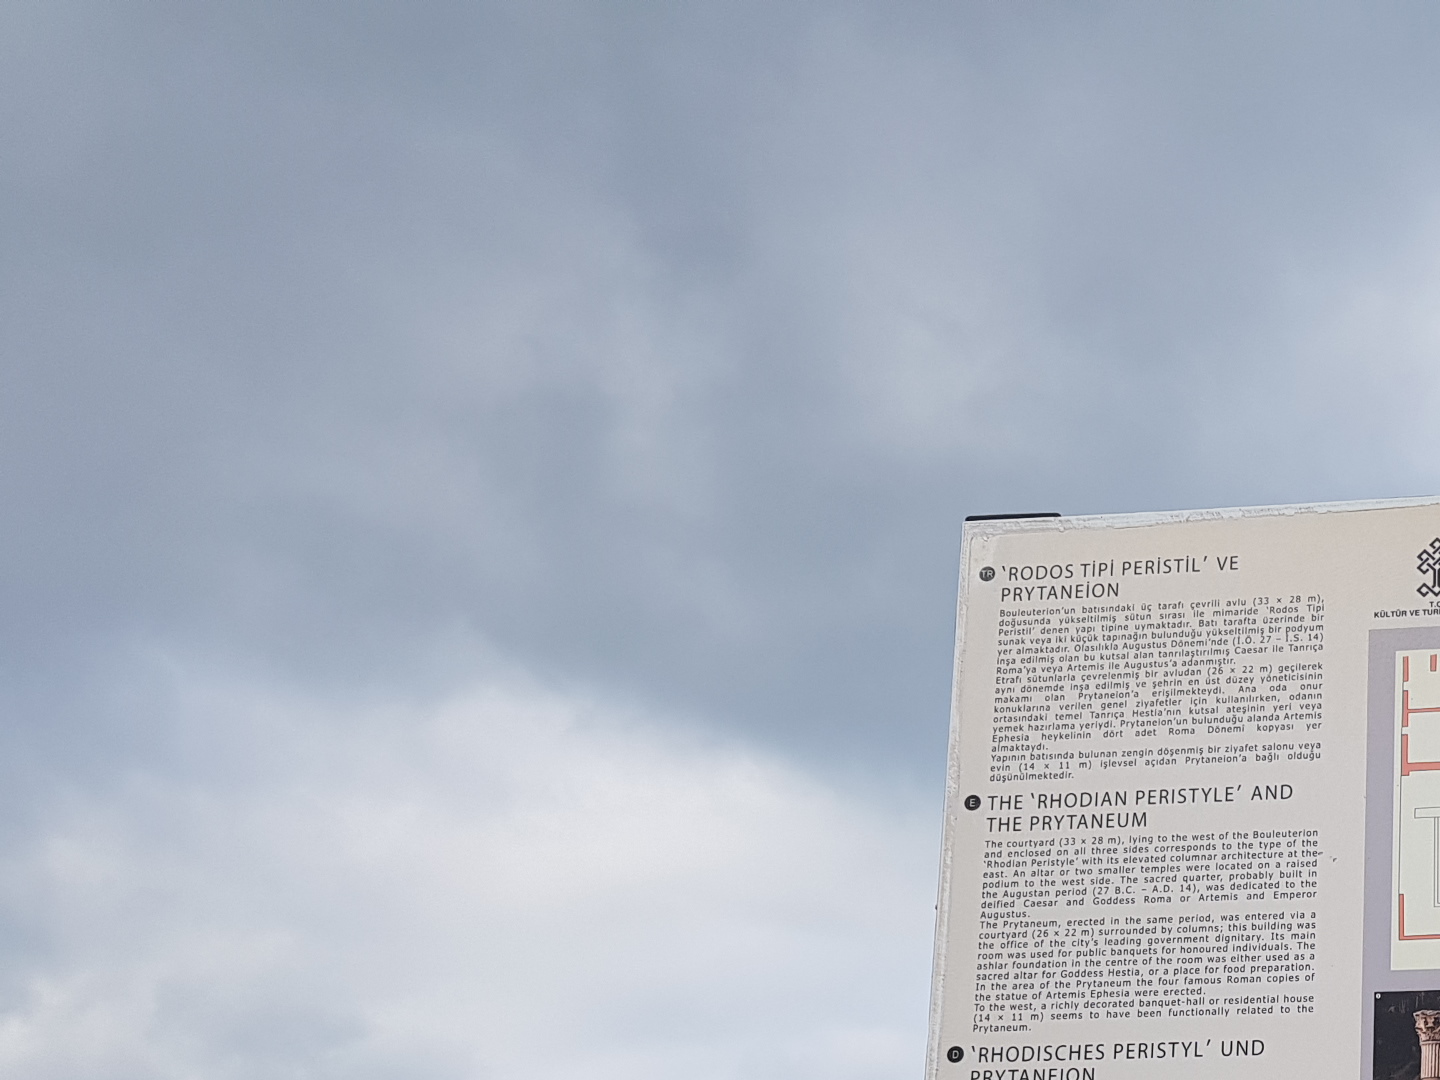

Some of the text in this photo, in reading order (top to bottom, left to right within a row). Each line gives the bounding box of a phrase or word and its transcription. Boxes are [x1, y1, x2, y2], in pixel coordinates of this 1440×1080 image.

[1080, 559, 1114, 578] TİPİ
[1217, 556, 1238, 571] VE
[1001, 581, 1119, 602] PRYTANEİON
[999, 618, 1051, 628] doğusunda
[1059, 615, 1116, 626] yükseltilmiş
[1125, 614, 1152, 622] sütun
[1213, 608, 1258, 617] mimaride
[1308, 605, 1324, 613] Tipi
[1374, 609, 1407, 618] KÜLTÜR
[988, 795, 1023, 811] THE
[1251, 784, 1293, 801] AND
[986, 812, 1147, 832] THE PRYTANEUM
[984, 850, 1002, 859] and
[1008, 848, 1051, 858] enclosed
[1074, 847, 1086, 856] all
[1092, 847, 1118, 855] three
[1123, 846, 1149, 854] sides
[1154, 843, 1216, 853] corresponds
[1238, 842, 1254, 850] the
[1259, 842, 1281, 850] type
[1302, 840, 1318, 848] the
[1082, 857, 1103, 865] with
[1123, 855, 1166, 864] elevated
[1170, 854, 1218, 862] columnar
[1221, 852, 1284, 860] architecture
[1302, 850, 1318, 858] the
[1013, 870, 1026, 878] An
[1031, 869, 1054, 877] altar
[1075, 868, 1093, 876] two
[1098, 866, 1136, 875] smaller
[1141, 865, 1180, 874] temples
[1186, 864, 1210, 872] were
[1216, 862, 1252, 871] located
[1286, 860, 1317, 868] raised
[974, 1003, 985, 1012] To
[989, 1003, 1005, 1012] the
[1051, 1001, 1079, 1010] richly
[1084, 999, 1134, 1009] decorated
[1139, 998, 1205, 1008] banquet-hall
[1224, 996, 1279, 1005] residential
[1284, 995, 1314, 1003] house
[975, 993, 991, 1002] the
[996, 993, 1028, 1001] statue
[1032, 991, 1042, 1000] of
[1046, 990, 1086, 999] Artemis
[1090, 989, 1130, 999] Ephesia
[1221, 1040, 1264, 1057] UND
